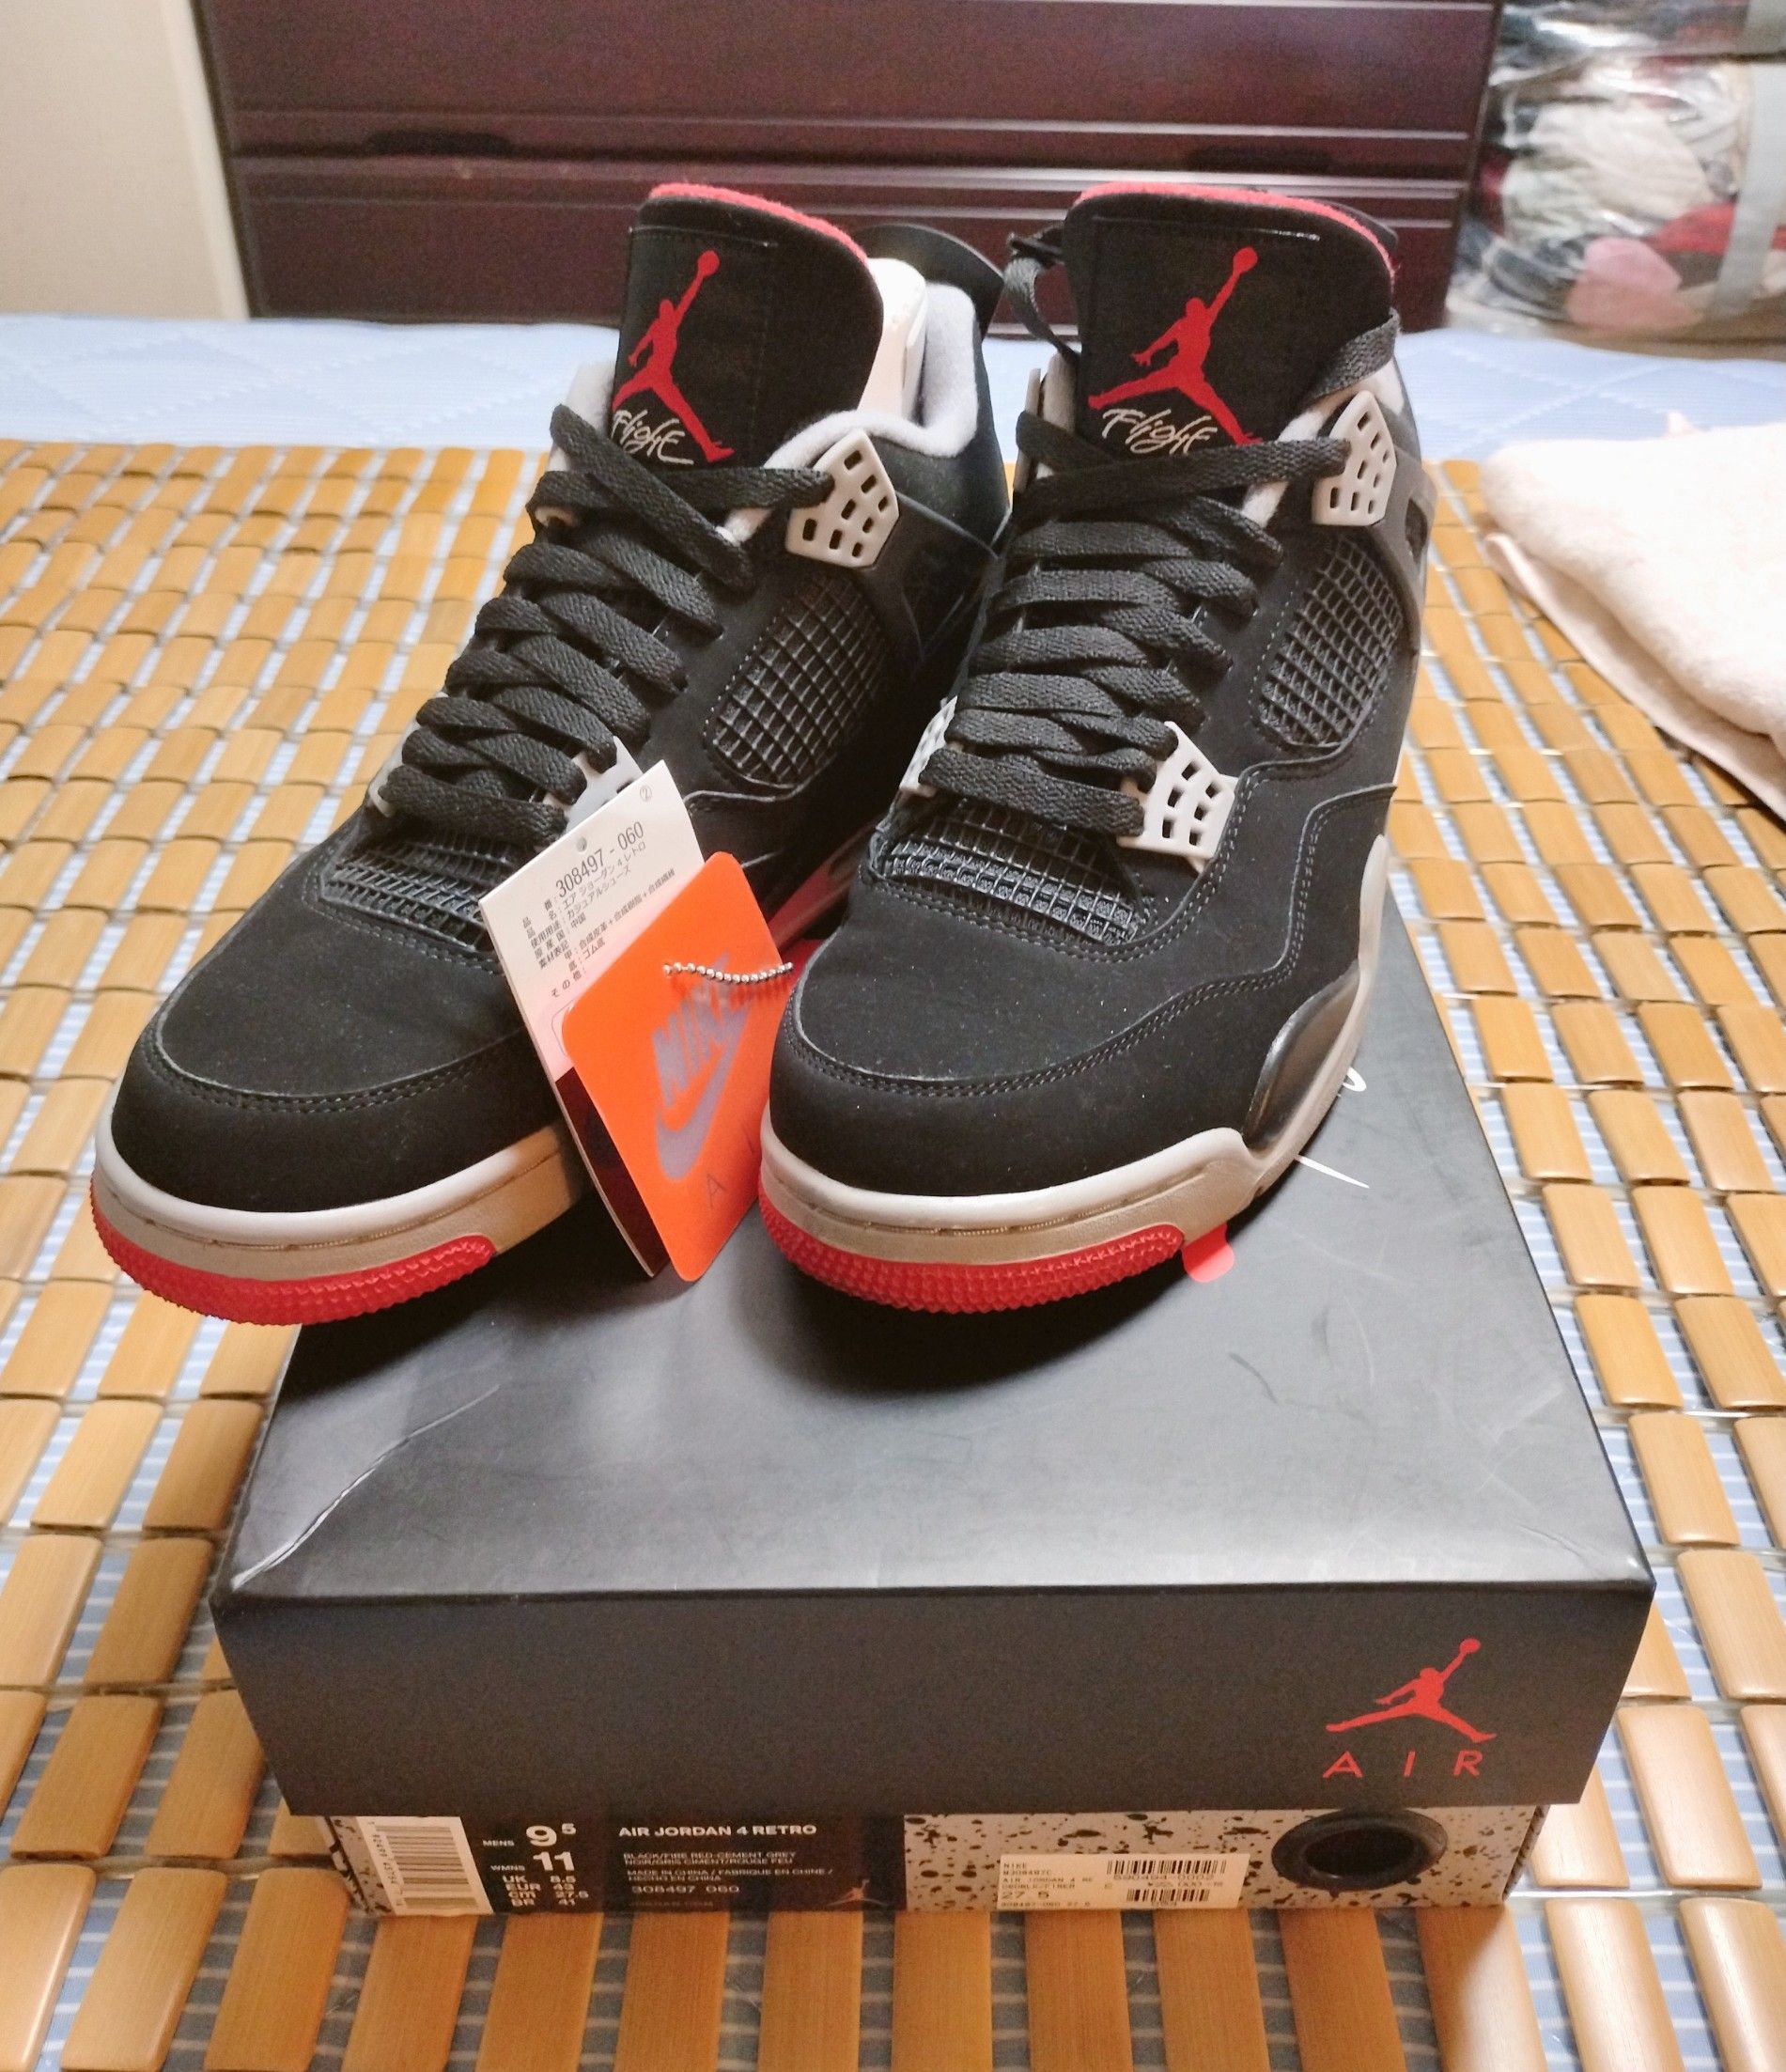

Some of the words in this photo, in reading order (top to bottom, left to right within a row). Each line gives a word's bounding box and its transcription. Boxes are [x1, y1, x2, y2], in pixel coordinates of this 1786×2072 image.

[556, 849, 604, 897] 308497
[617, 821, 644, 849] 060
[1322, 1750, 1483, 1779] AIR
[618, 1827, 650, 1837] AIR
[655, 1826, 732, 1837] JORDAN
[737, 1826, 749, 1836] 4
[753, 1824, 817, 1835] RETRO
[482, 1839, 515, 1847] MENS
[533, 1851, 575, 1871] 11
